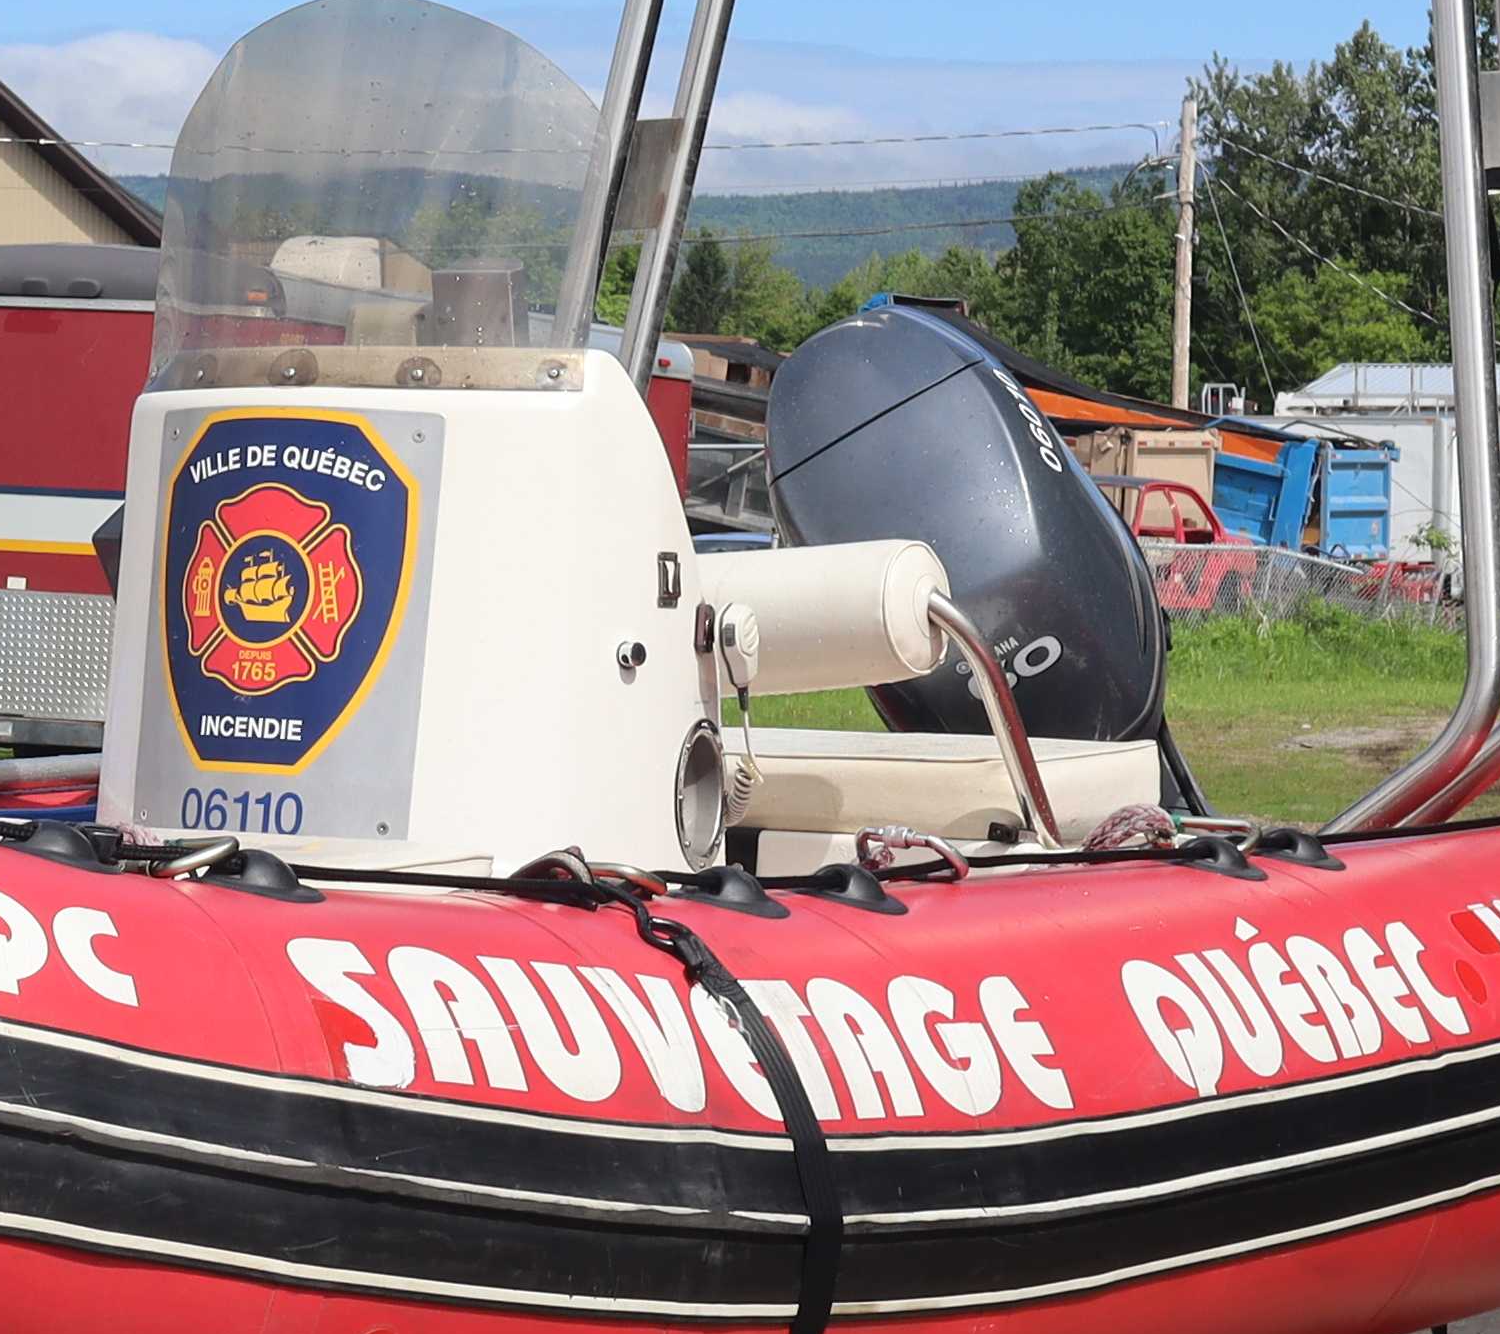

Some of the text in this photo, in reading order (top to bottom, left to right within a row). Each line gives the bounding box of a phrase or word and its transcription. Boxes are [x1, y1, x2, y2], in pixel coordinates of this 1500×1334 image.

[188, 445, 387, 493] VILLE DE QUÉBEC
[238, 649, 273, 661] DEPUIS
[993, 636, 1020, 657] AHA
[231, 660, 277, 682] 1765
[199, 714, 303, 742] INCENDIE
[181, 787, 304, 836] 06110
[1120, 916, 1471, 1098] QUÉBEC
